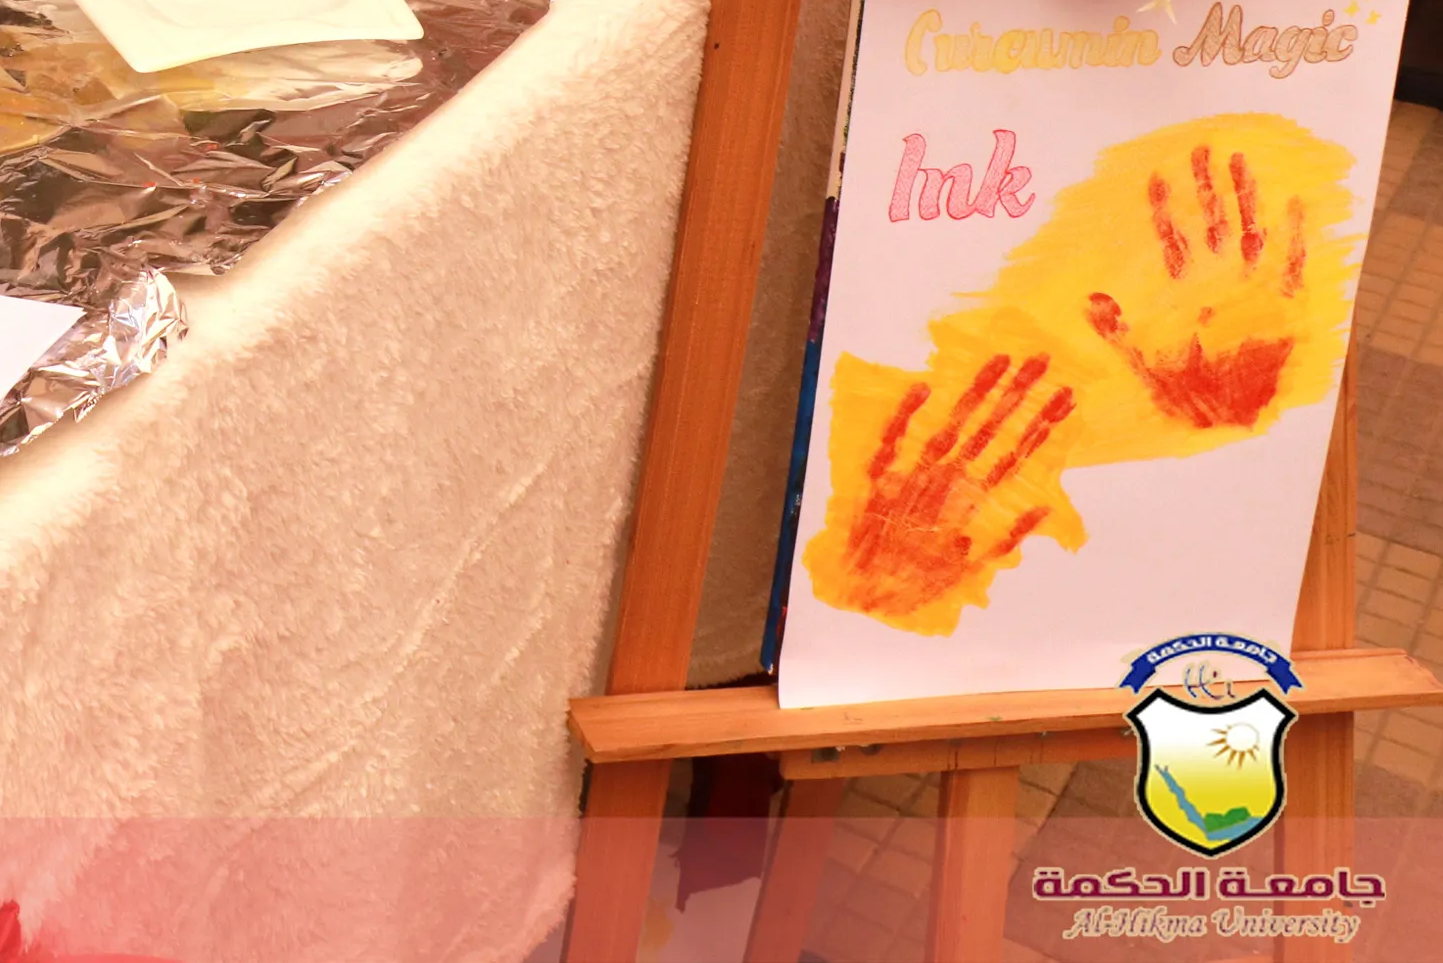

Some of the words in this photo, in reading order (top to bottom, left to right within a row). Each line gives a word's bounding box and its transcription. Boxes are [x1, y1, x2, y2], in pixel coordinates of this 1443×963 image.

[905, 9, 1162, 76] Curcumin
[1173, 1, 1359, 79] Magic
[888, 129, 1036, 223] Ink
